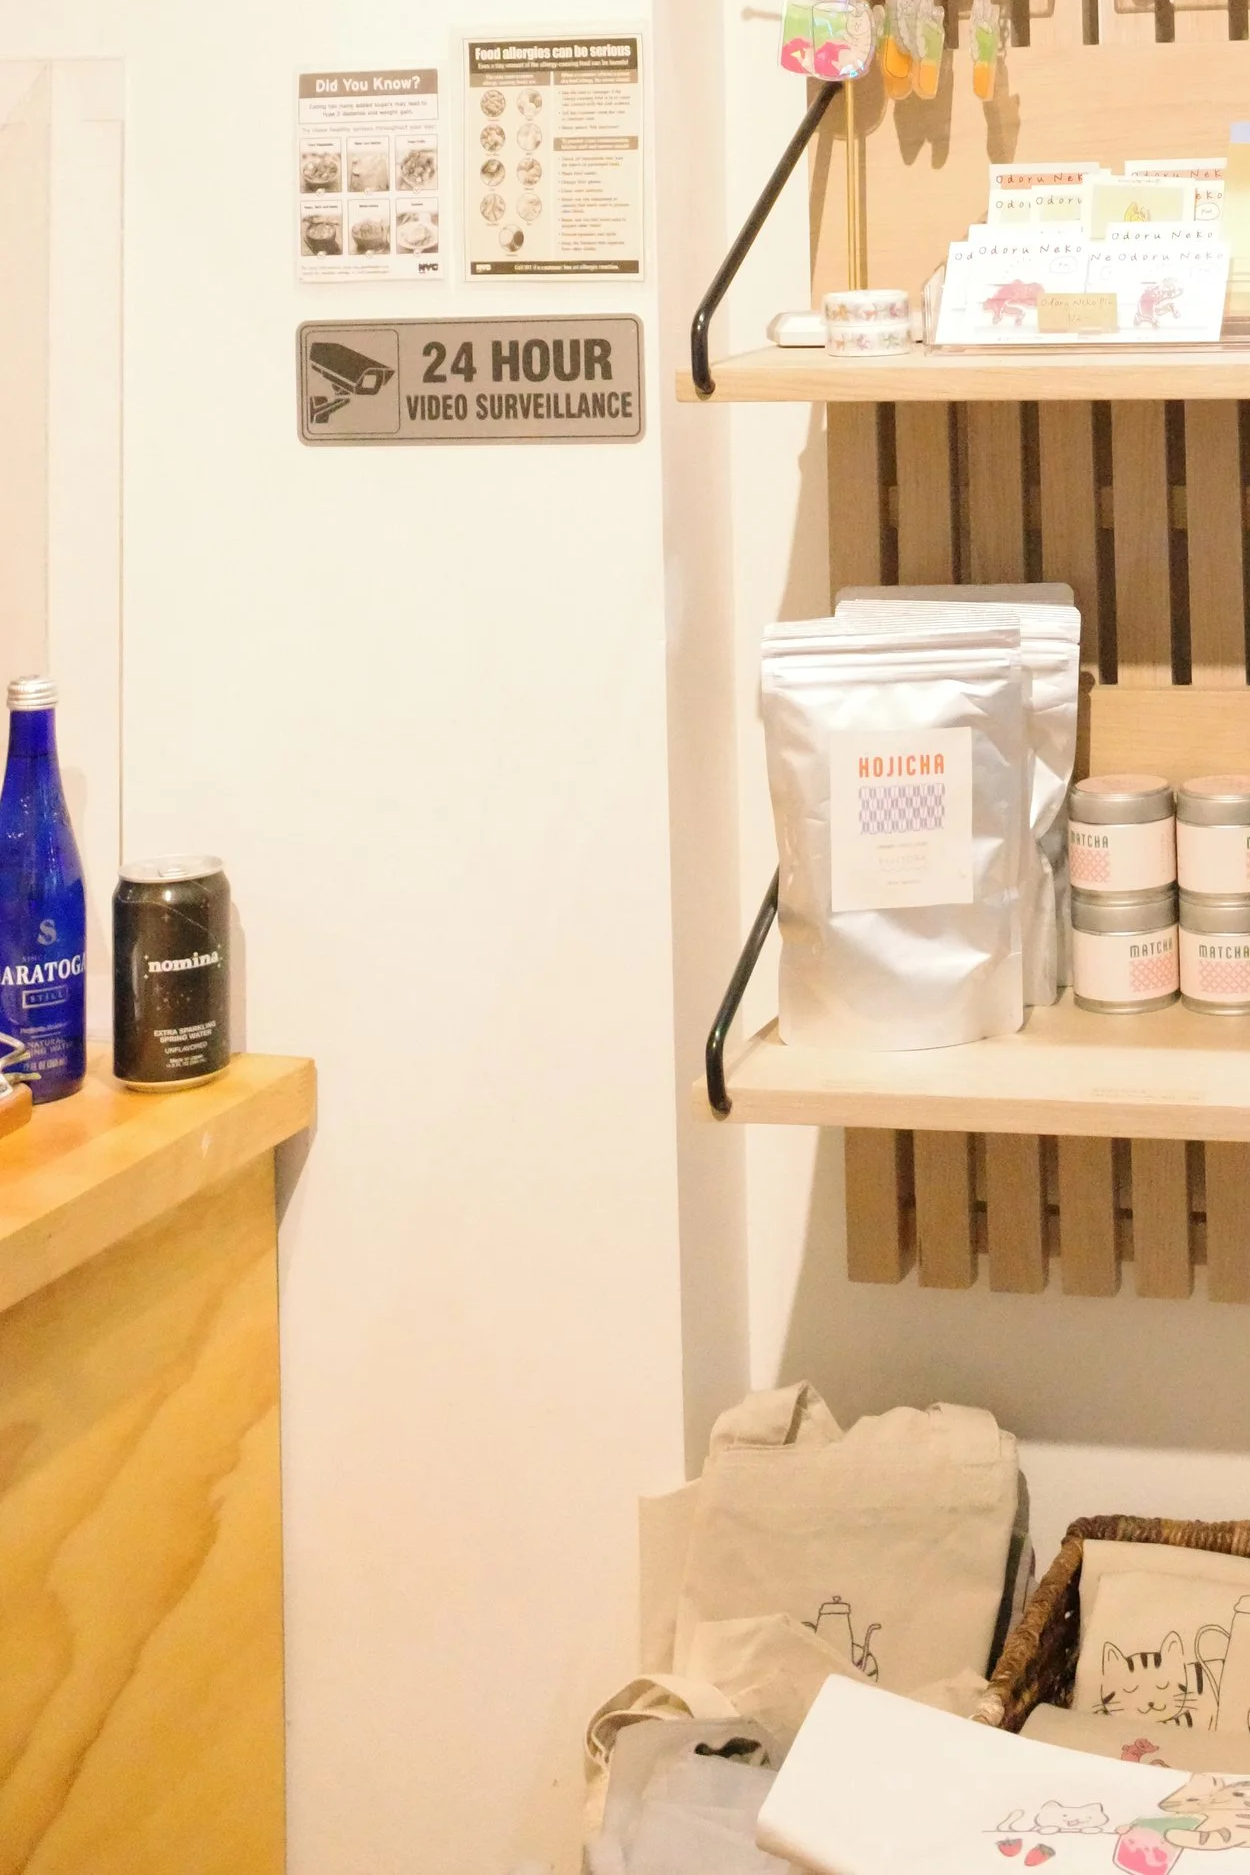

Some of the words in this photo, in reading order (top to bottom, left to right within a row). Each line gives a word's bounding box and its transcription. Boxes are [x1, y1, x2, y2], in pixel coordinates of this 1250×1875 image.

[475, 48, 501, 61] Food
[503, 46, 550, 61] allergies
[553, 47, 572, 58] can
[574, 44, 588, 58] be
[590, 44, 631, 57] serious
[316, 79, 337, 93] Did
[343, 78, 368, 91] You
[373, 75, 420, 90] Know?
[996, 175, 1045, 184] Odoru
[1112, 232, 1161, 240] Odoru
[1172, 231, 1213, 239] Neko
[979, 246, 1030, 255] Odoru
[1040, 244, 1082, 253] Neko
[1118, 253, 1170, 261] Odoru
[1180, 252, 1223, 260] Neko
[422, 340, 477, 383] 24
[491, 338, 613, 382] HOUR
[406, 393, 468, 421] VIDEO
[476, 392, 633, 421] SURVEILLANCE
[859, 753, 944, 778] HOJICHA
[1071, 830, 1109, 849] MATCHA
[37, 919, 57, 945] S
[1130, 937, 1173, 958] MATCHA
[1199, 944, 1250, 959] MATCHA
[148, 951, 219, 973] nomina
[29, 992, 64, 1003] STILL
[154, 1028, 178, 1037] EXTRA
[179, 1020, 216, 1034] SPARKLING
[160, 1034, 188, 1043] SPRING
[188, 1028, 212, 1039] WATER
[165, 1041, 208, 1054] UNFLAVORED
